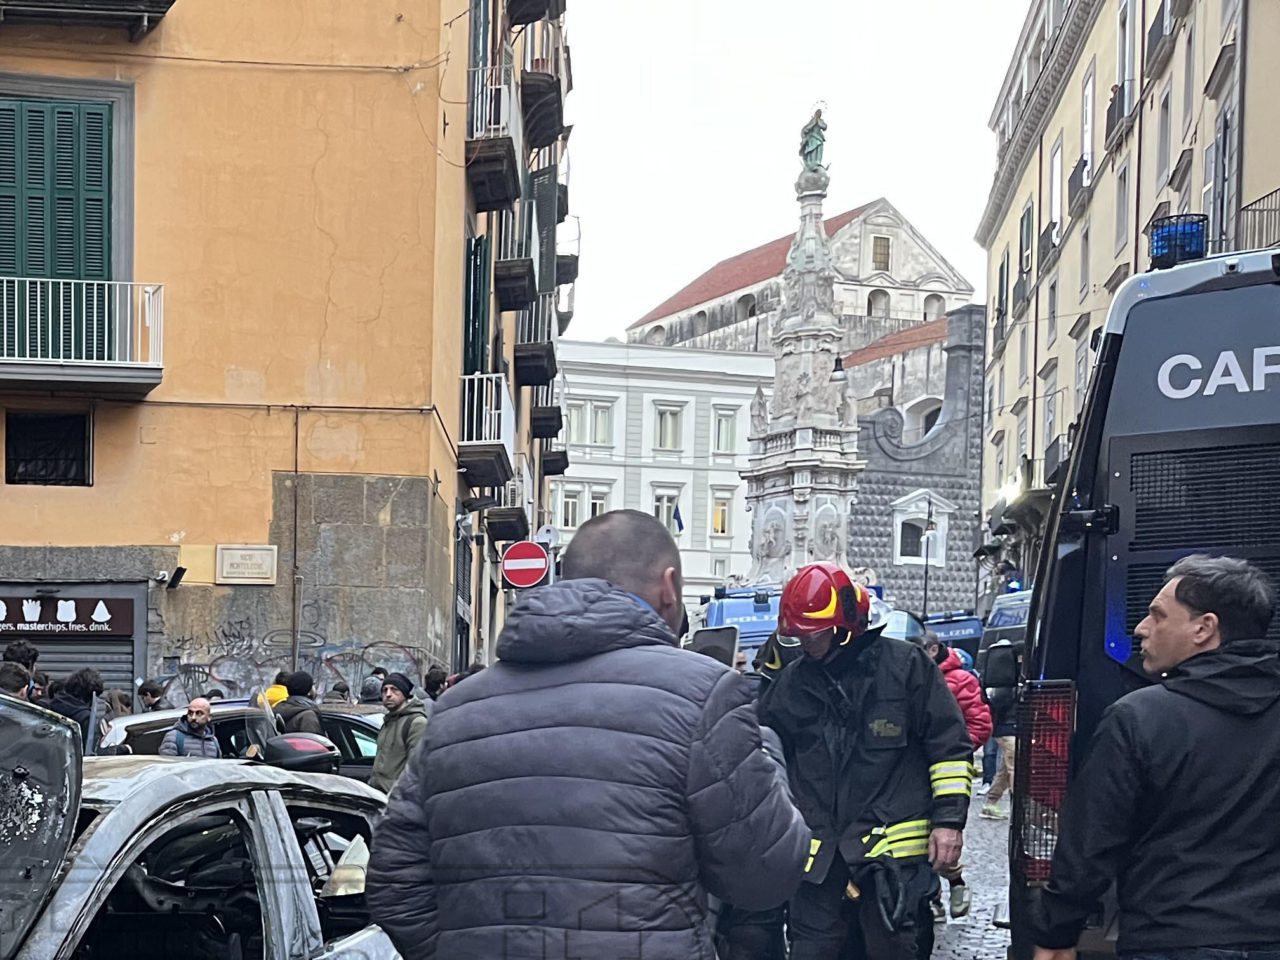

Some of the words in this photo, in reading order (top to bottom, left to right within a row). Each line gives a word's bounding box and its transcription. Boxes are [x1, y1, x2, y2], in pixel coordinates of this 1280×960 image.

[725, 615, 778, 624] POLIZ
[17, 621, 68, 633] masterchips.
[935, 628, 975, 638] OLIZIA
